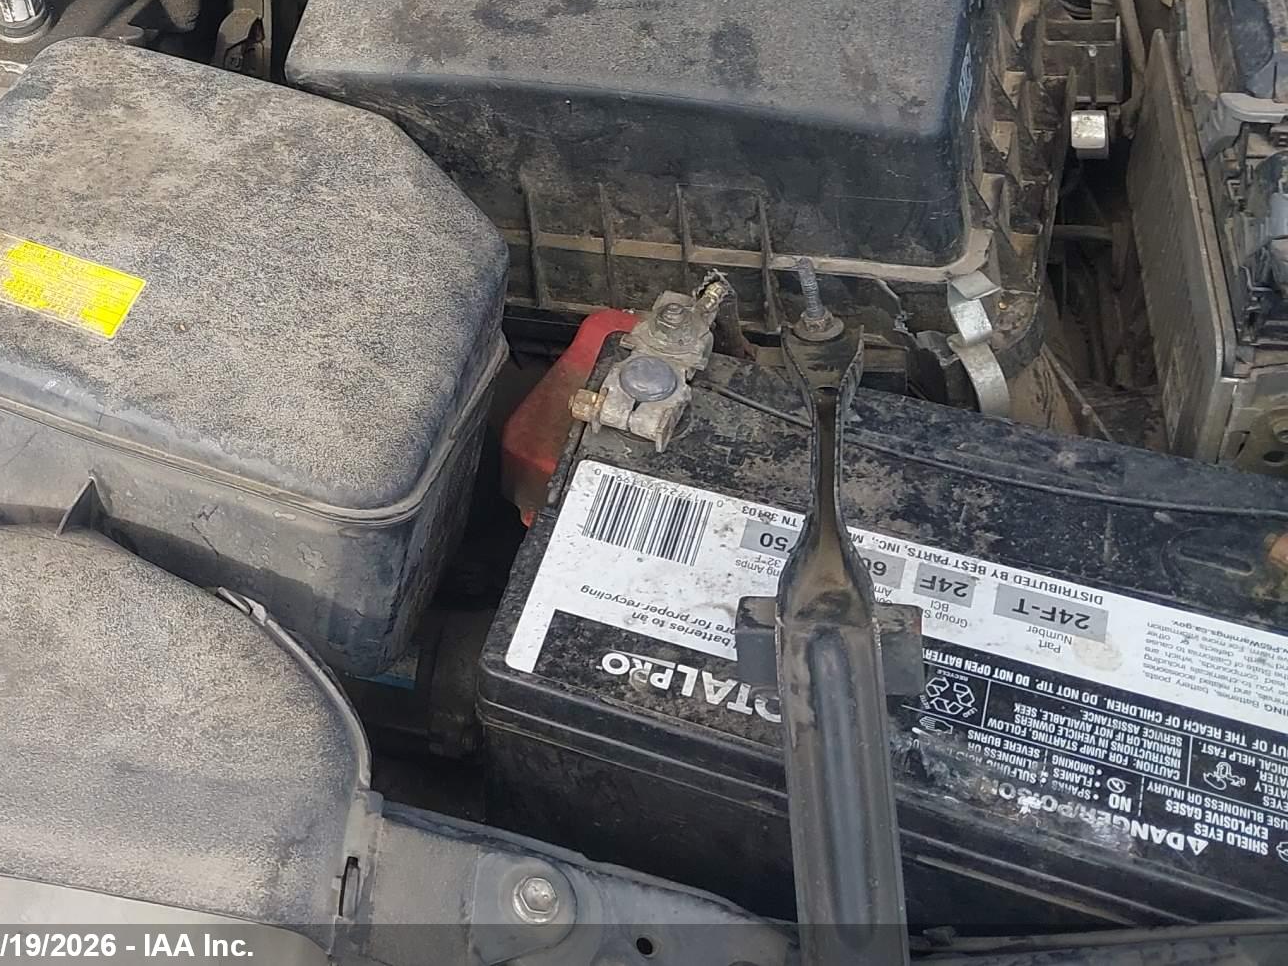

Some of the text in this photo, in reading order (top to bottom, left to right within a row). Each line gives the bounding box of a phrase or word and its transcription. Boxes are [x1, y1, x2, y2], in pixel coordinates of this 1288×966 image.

[715, 499, 724, 508] 0
[780, 515, 797, 527] TN
[869, 535, 901, 552] INC.,
[902, 543, 949, 565] PARTS,
[733, 557, 768, 574] Amps
[952, 557, 987, 575] BEST
[990, 567, 1009, 580] BY
[919, 571, 969, 599] 24F
[1012, 572, 1103, 606] DISTRIBUTED
[579, 583, 641, 609] recycling
[643, 601, 689, 622] proper
[929, 598, 950, 612] BCI
[1011, 595, 1091, 631] 24F-T
[690, 616, 712, 630] for
[933, 610, 968, 628] Group
[630, 610, 730, 646] batteries to an
[1025, 624, 1073, 645] Number
[1037, 638, 1061, 654] Part
[1174, 644, 1185, 653] to
[962, 659, 991, 676] OPEN
[1142, 652, 1186, 671] including
[935, 668, 968, 682] RECYCLE
[991, 666, 1014, 682] NOT
[1013, 672, 1030, 687] DO
[1141, 669, 1171, 684] posts,
[1032, 677, 1056, 693] TIP.
[1055, 684, 1080, 700] NOT
[1175, 678, 1209, 694] battery
[1080, 691, 1098, 705] DO
[1012, 701, 1038, 717] SEEK
[1101, 696, 1163, 723] CHILDREN.
[1037, 708, 1093, 732] AVAILABLE,
[1077, 708, 1183, 746] SERVICE ASSISTANCE.
[1163, 713, 1181, 727] OF
[1181, 718, 1223, 739] REACH
[1012, 712, 1182, 768] INSTRUCTIONS IN VEHICLE OWNERS
[1092, 724, 1114, 739] NOT
[1113, 730, 1125, 742] IF
[1222, 730, 1249, 746] THE
[966, 728, 1041, 757] SEVERE BURNS
[986, 716, 1181, 780] CAUTION: FOR JUMP STARTING, FOLLOW
[1196, 741, 1227, 758] FAST.
[1250, 737, 1268, 752] OF
[1270, 743, 1288, 757] UT
[1050, 753, 1095, 774] SMOKING
[1227, 750, 1257, 766] HELP
[1051, 766, 1093, 787] FLAMES
[1254, 769, 1288, 788] ATER.
[1146, 780, 1185, 799] INJURY
[1186, 791, 1203, 805] OR
[1106, 792, 1133, 812] NO
[1202, 795, 1265, 822] BLINDNESS
[1163, 798, 1270, 839] EXPLOSIVE GASES
[1191, 821, 1270, 855] SHIELD EYES
